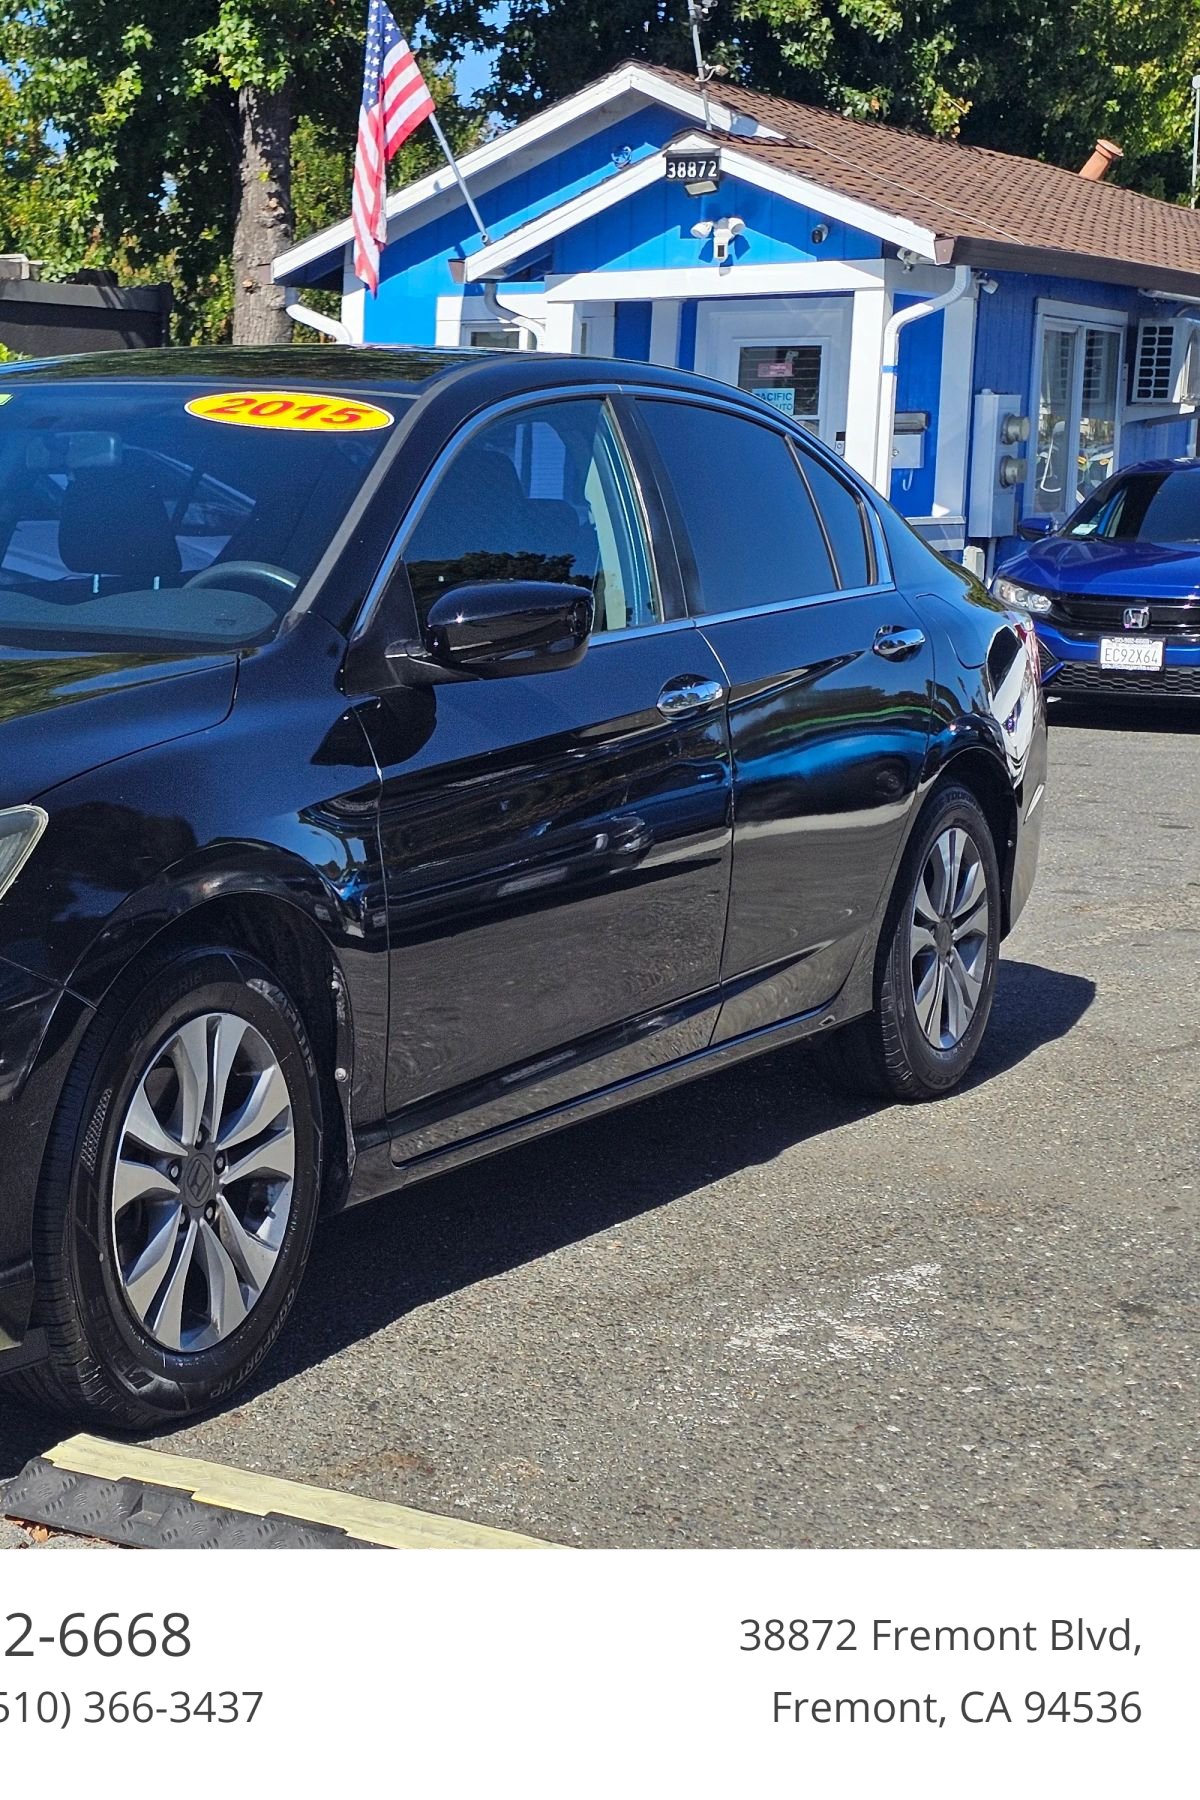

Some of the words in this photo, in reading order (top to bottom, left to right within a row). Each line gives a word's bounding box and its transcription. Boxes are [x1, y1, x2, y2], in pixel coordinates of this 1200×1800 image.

[667, 161, 717, 178] 38872
[204, 398, 373, 424] 2015
[1105, 647, 1157, 664] EC92X64
